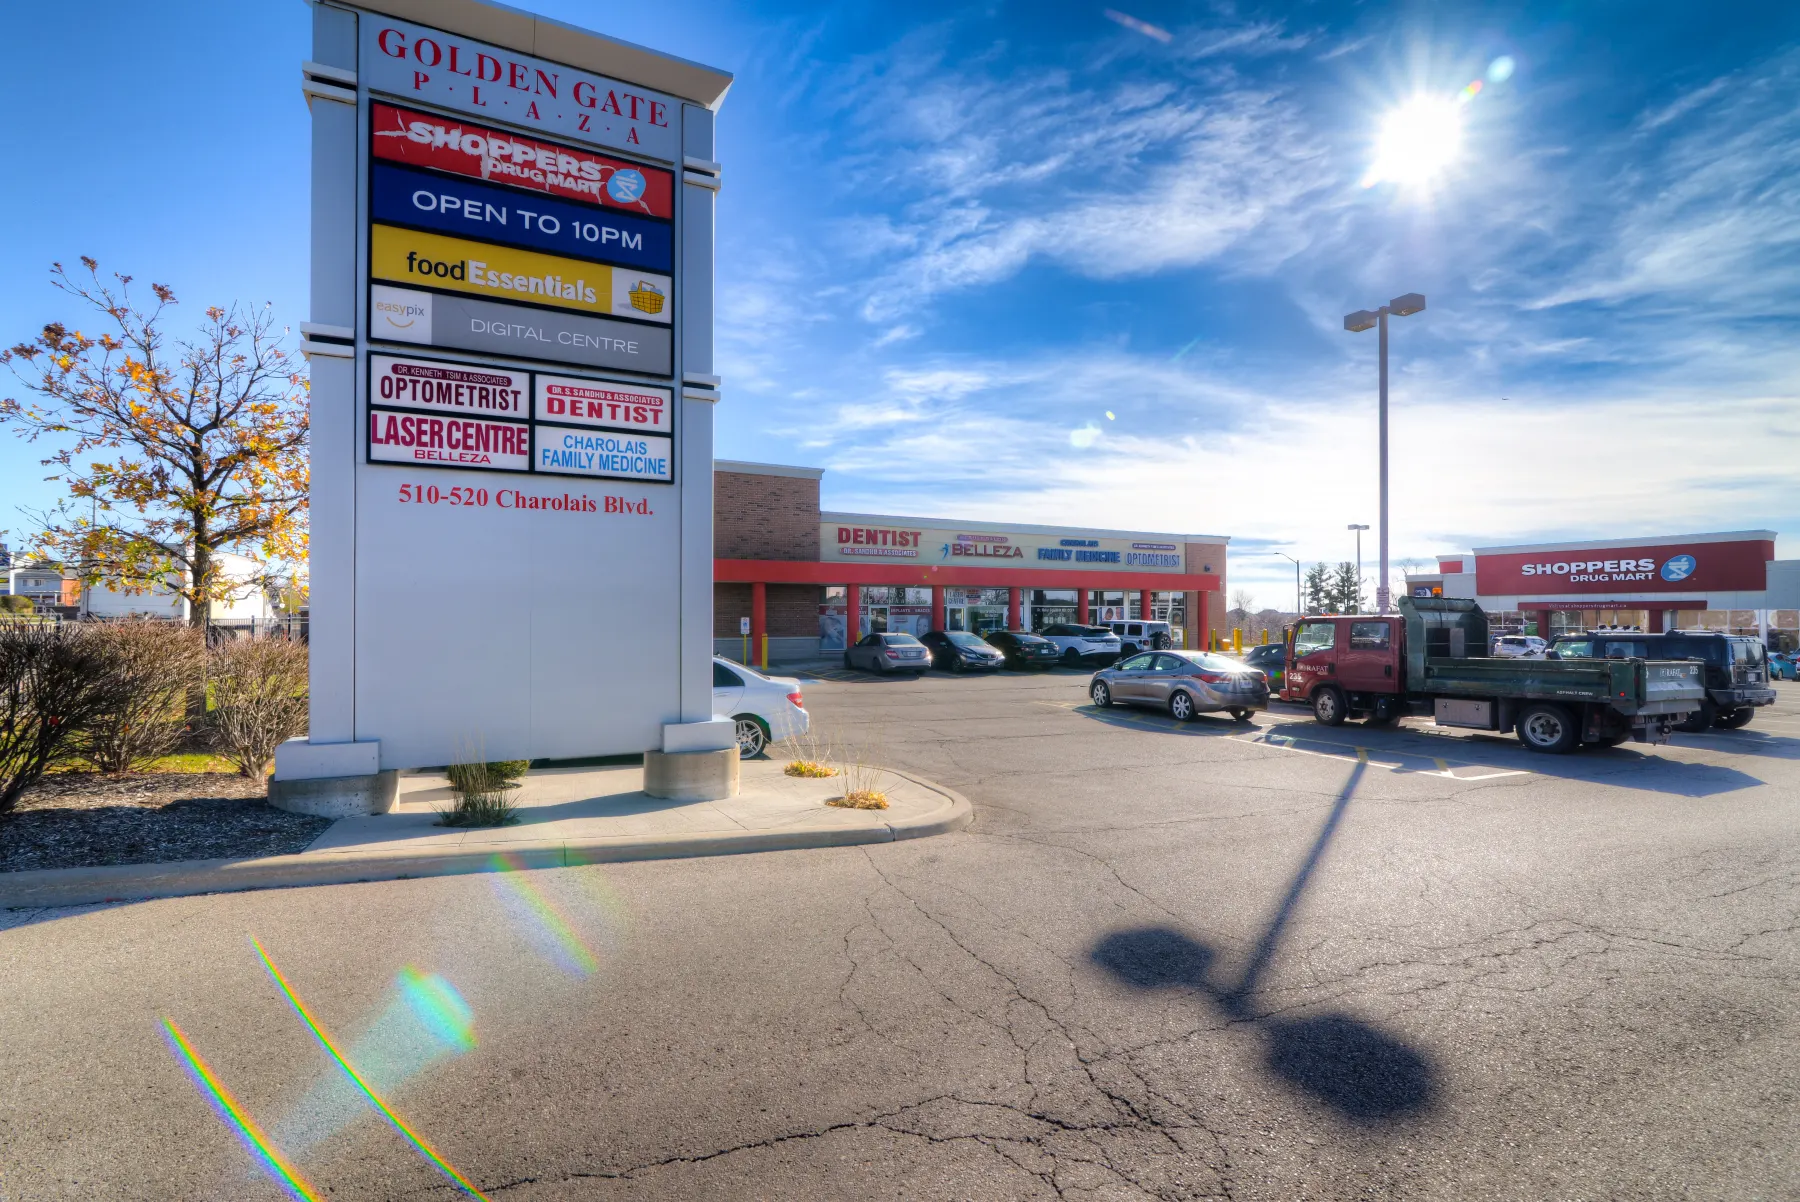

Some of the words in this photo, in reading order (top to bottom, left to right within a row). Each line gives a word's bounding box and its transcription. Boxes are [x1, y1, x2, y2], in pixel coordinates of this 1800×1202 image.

[378, 28, 559, 100] GOLDEN
[573, 81, 668, 128] GATE
[408, 121, 602, 180] SHOPPERS
[488, 159, 546, 183] DRUG
[547, 172, 602, 195] MART
[412, 190, 507, 226] OPEN
[516, 209, 561, 235] TO
[571, 220, 643, 251] 10PM
[376, 300, 425, 317] easypix
[470, 318, 552, 343] DIGITAL
[558, 331, 640, 355] CENTRE
[410, 367, 443, 378] KENNETH
[445, 371, 461, 381] TSIM
[468, 374, 508, 386] ASSOCIATES
[380, 375, 522, 412] OPTOMETRIST
[551, 386, 564, 395] DR.
[565, 387, 572, 395] S.
[573, 388, 605, 399] SANDHU
[606, 392, 612, 400] &
[613, 393, 661, 405] ASSOCIATES
[546, 396, 663, 425] DENTIST
[371, 413, 444, 449] LASER
[446, 420, 528, 456] CENTRE
[563, 434, 648, 455] CHAROLAIS
[414, 449, 491, 465] BELLEZA
[542, 448, 595, 470] FAMILY
[599, 453, 666, 475] MEDICINE
[398, 483, 489, 507] 510-520
[495, 489, 597, 513] Charolais
[603, 495, 654, 516] Blvd.
[837, 527, 922, 547] DENTIST
[951, 543, 1024, 559] BELLEZA
[1037, 548, 1073, 561] FAMILY
[1126, 552, 1180, 567] OPTOMETRIST
[1521, 558, 1656, 576] SHOPPERS
[1570, 574, 1609, 583] DRUG
[1613, 572, 1655, 581] MART
